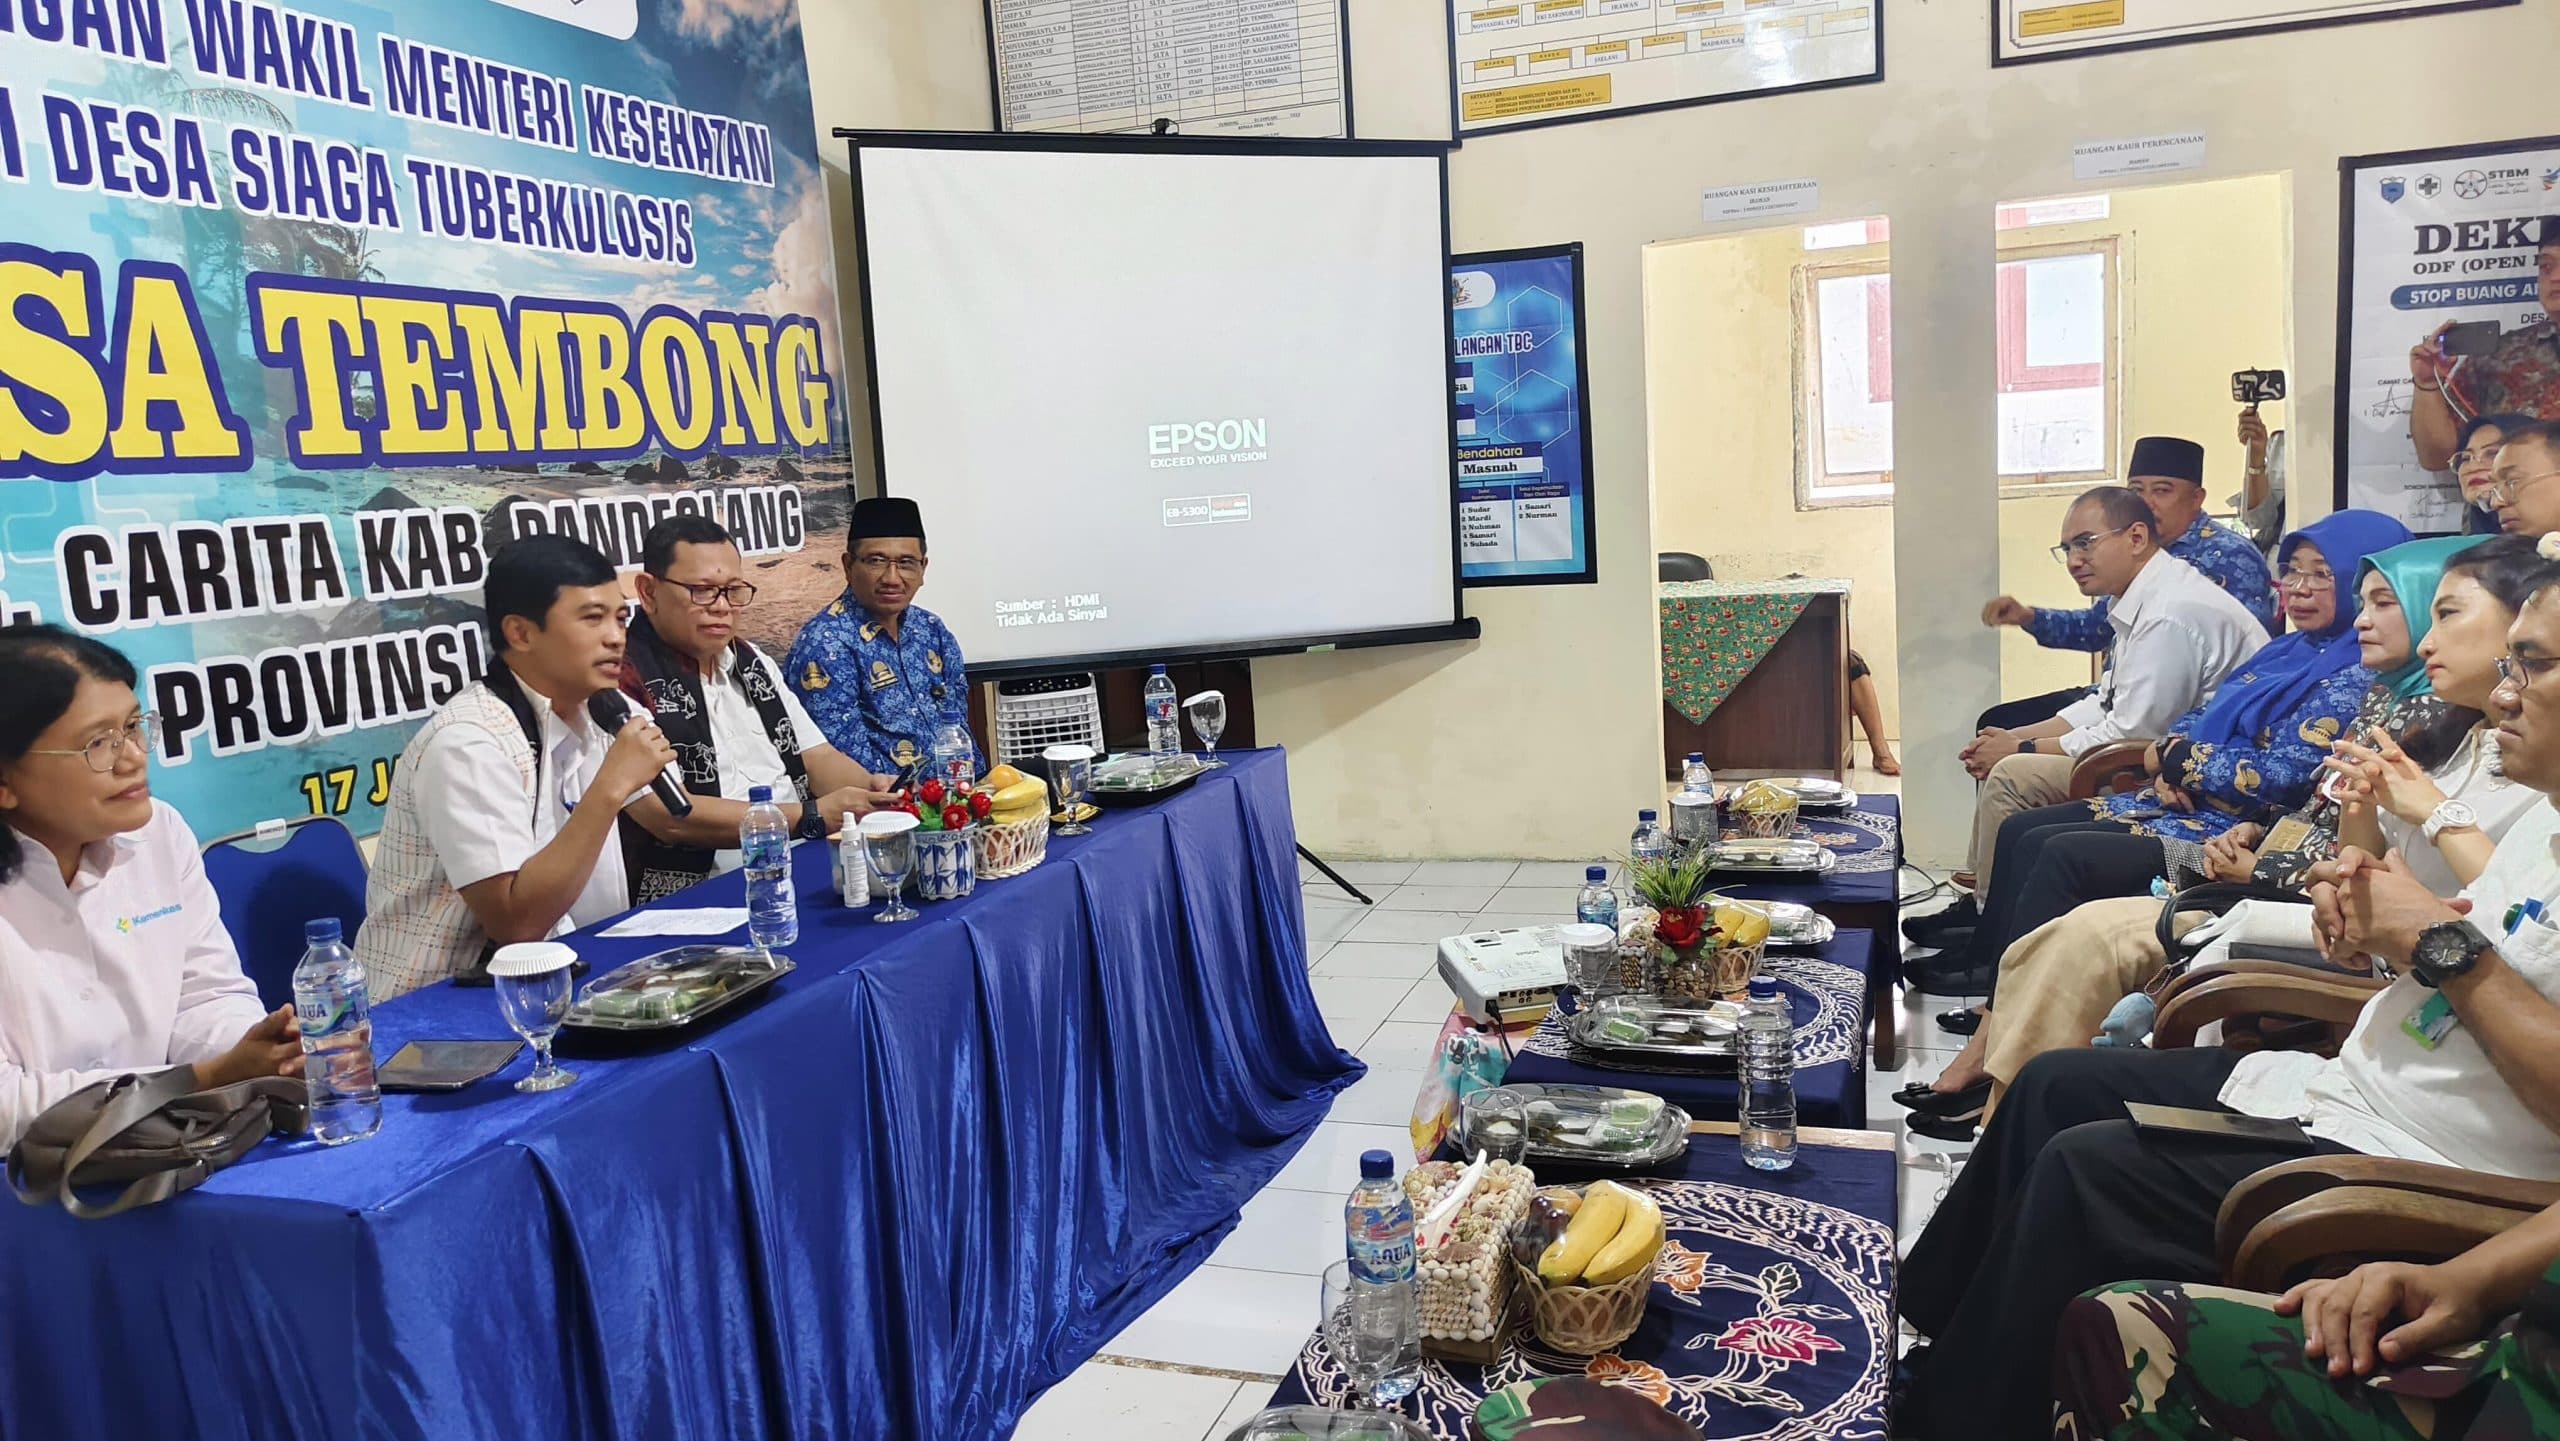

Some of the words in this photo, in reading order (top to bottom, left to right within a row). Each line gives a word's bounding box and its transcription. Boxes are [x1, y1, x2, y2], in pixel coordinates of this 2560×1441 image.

[0, 0, 166, 64] GAN
[185, 0, 371, 106] WAKIL
[382, 38, 575, 148] MENTERI
[584, 90, 774, 184] KESEHATAN
[2074, 145, 2115, 155] RUANGAN
[2142, 135, 2204, 149] PERENCANAAN
[42, 95, 217, 204] DESA
[231, 128, 400, 228] SIAGA
[407, 160, 695, 264] TUBERKULOSIS
[2488, 168, 2529, 179] STBM
[1704, 190, 1739, 200] RUANGAN
[1757, 181, 1817, 193] KESEJAHTERAAN
[2413, 261, 2455, 275] ODF
[2462, 255, 2527, 274] (OPEN
[2410, 288, 2451, 304] STOP
[2456, 284, 2516, 300] BUANG
[1507, 332, 1531, 352] TBC
[0, 261, 240, 465] SA
[259, 286, 830, 457] TEMBONG
[1149, 418, 1266, 455] EPSON
[1151, 456, 1195, 468] EXCEED
[1197, 454, 1227, 465] YOUR
[1230, 451, 1267, 463] VISION
[1457, 447, 1523, 460] Bendahara
[1463, 462, 1518, 474] Masnah
[64, 522, 344, 625] CARITA
[516, 489, 801, 567] ANDANG
[995, 599, 1046, 614] Sumber
[1065, 593, 1100, 608] HDMI
[996, 611, 1033, 627] Tidak
[1037, 610, 1064, 624] Ada
[1068, 606, 1107, 622] Sinyal
[154, 630, 482, 758] PROVINSI
[304, 769, 354, 815] 17
[371, 757, 401, 802] J
[300, 1003, 328, 1021] QUA
[1371, 1244, 1411, 1266] AQUA
